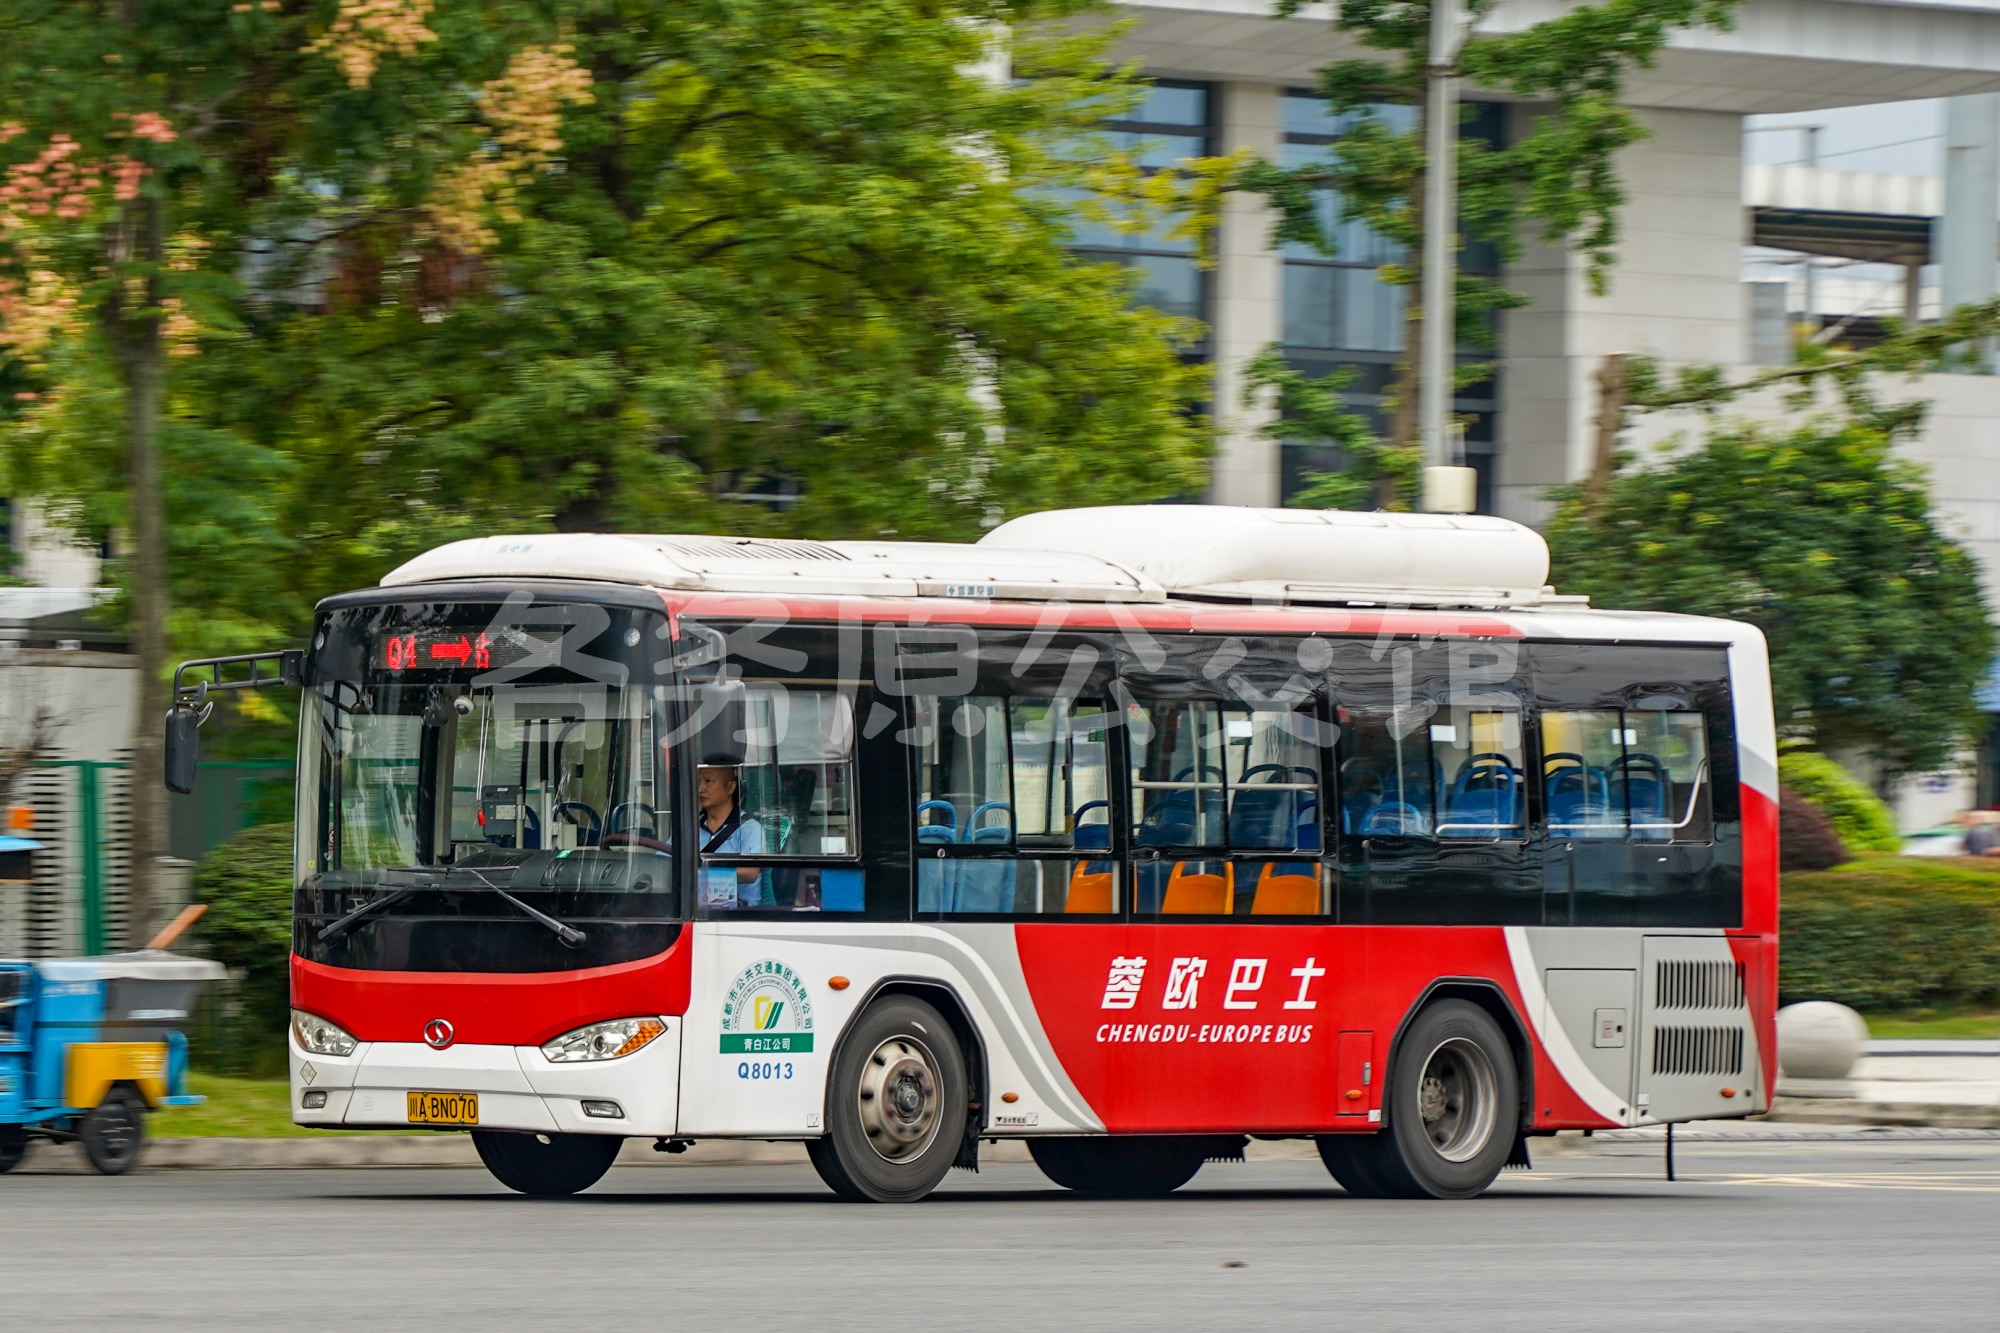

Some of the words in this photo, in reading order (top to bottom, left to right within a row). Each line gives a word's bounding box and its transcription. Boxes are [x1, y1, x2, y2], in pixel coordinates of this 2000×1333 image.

[1101, 956, 1326, 1010] 蓉欧巴士
[722, 961, 812, 1030] 成都市公共交通集团有限公司
[1096, 1024, 1274, 1043] CHENGDU-EUROPE
[1275, 1024, 1313, 1043] BUS
[744, 1038, 791, 1051] 青白江公司
[738, 1062, 793, 1080] Q8013
